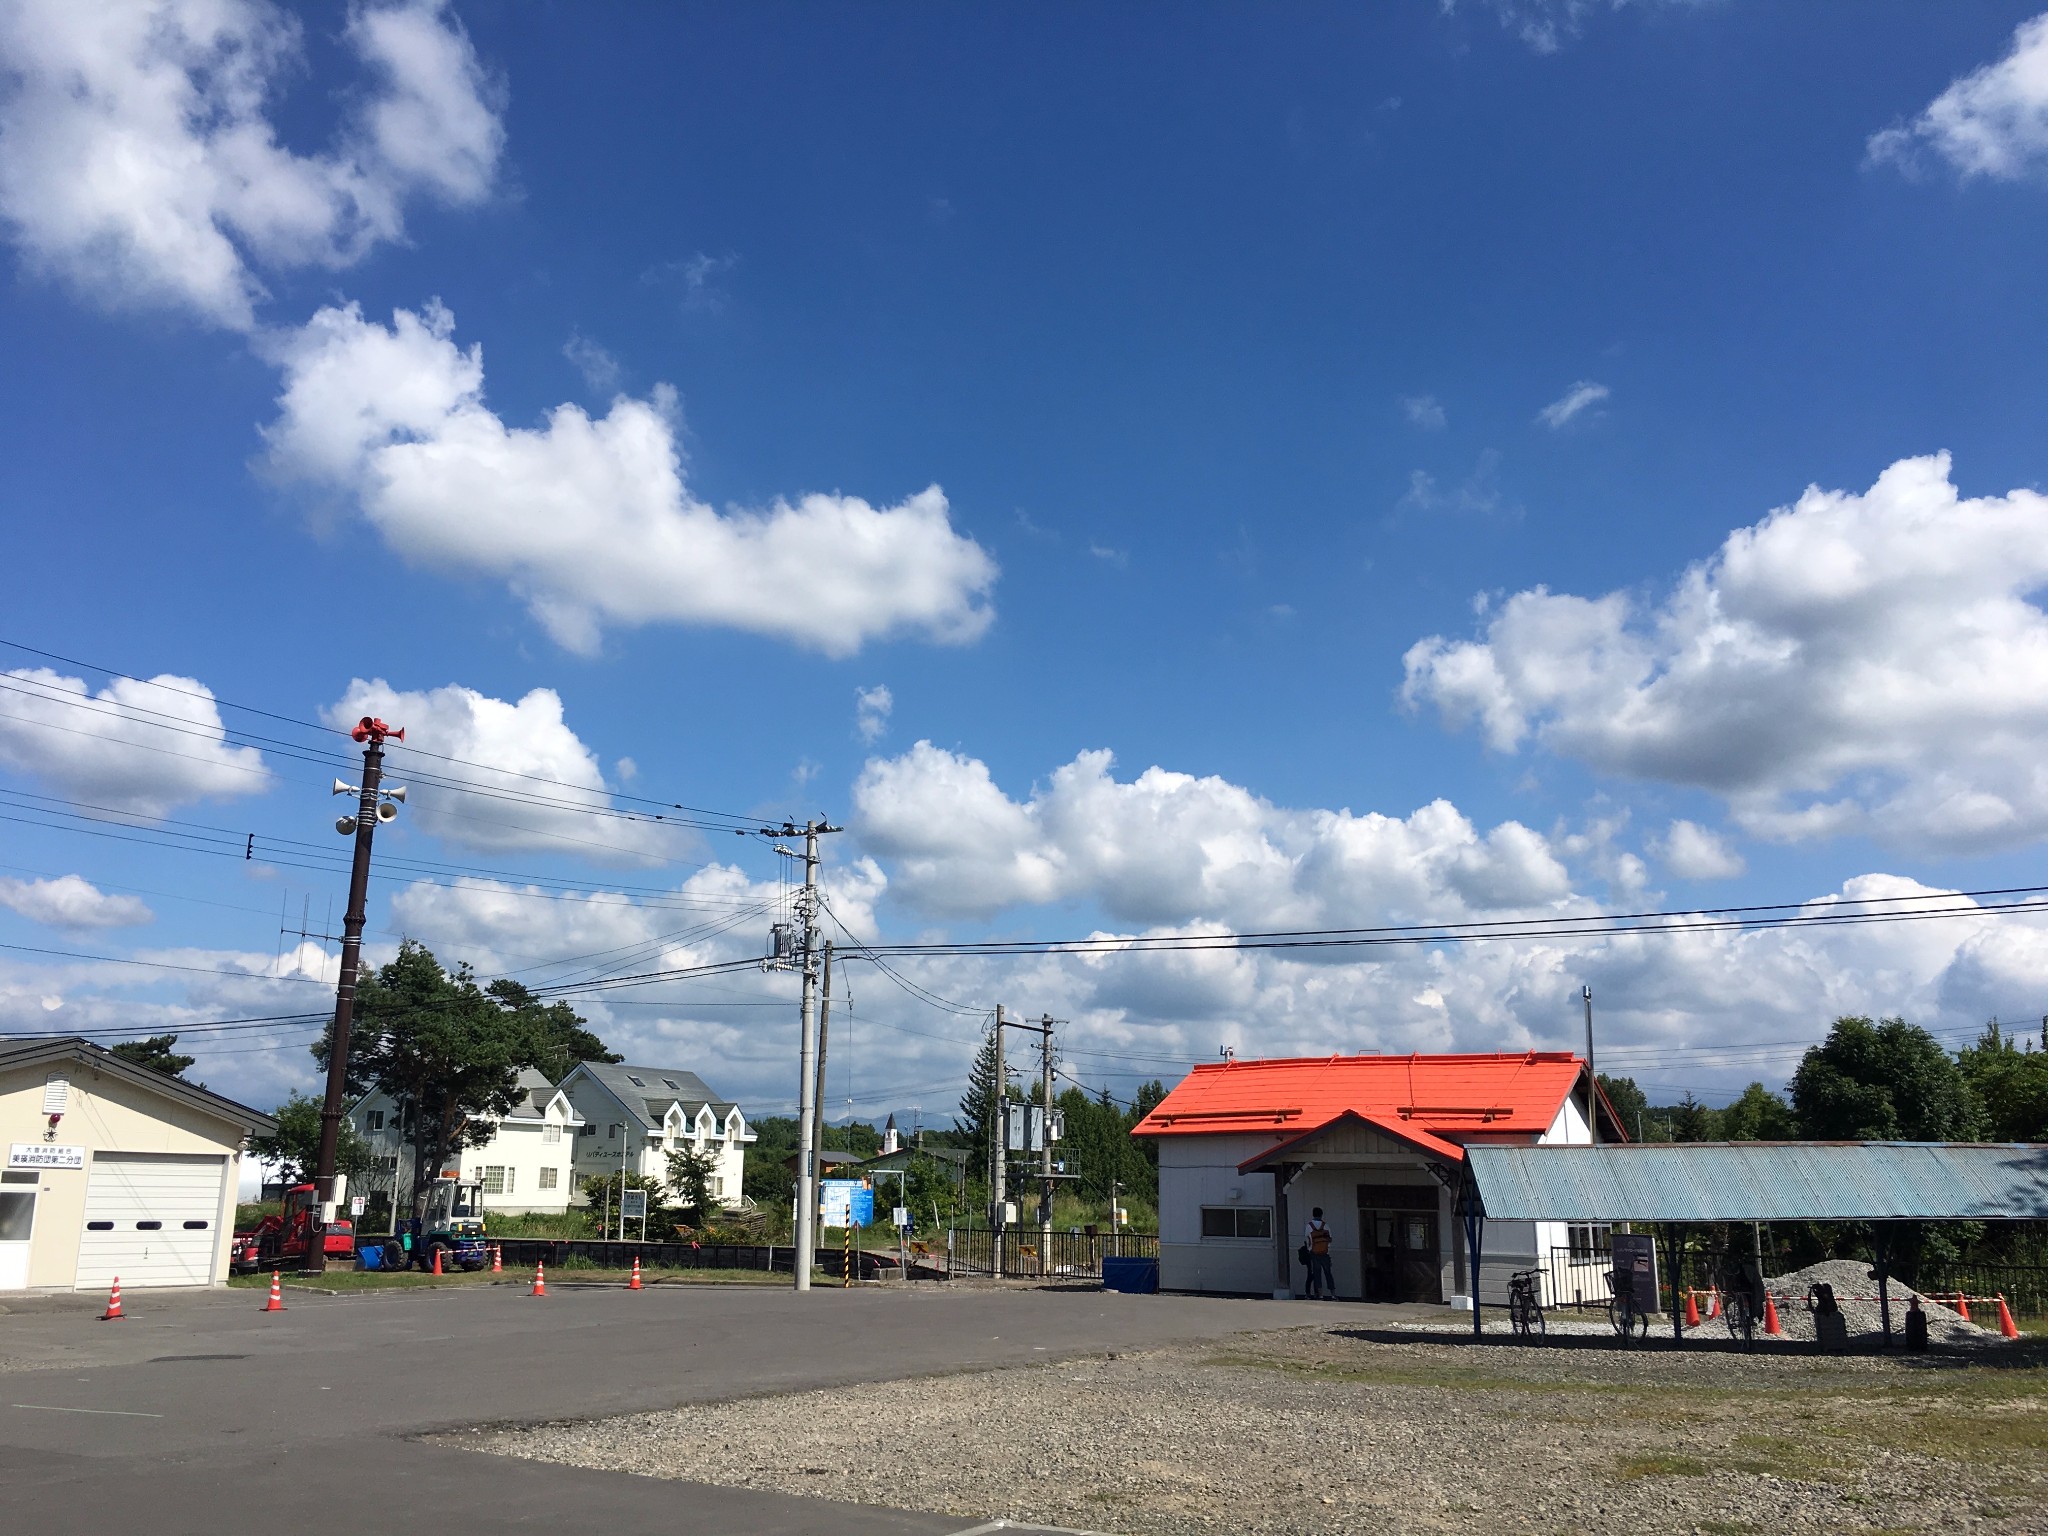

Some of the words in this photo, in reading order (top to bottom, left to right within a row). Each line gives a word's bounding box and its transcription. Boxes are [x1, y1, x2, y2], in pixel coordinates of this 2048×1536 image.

[12, 1154, 82, 1164] 美瑛消防団第二分団
